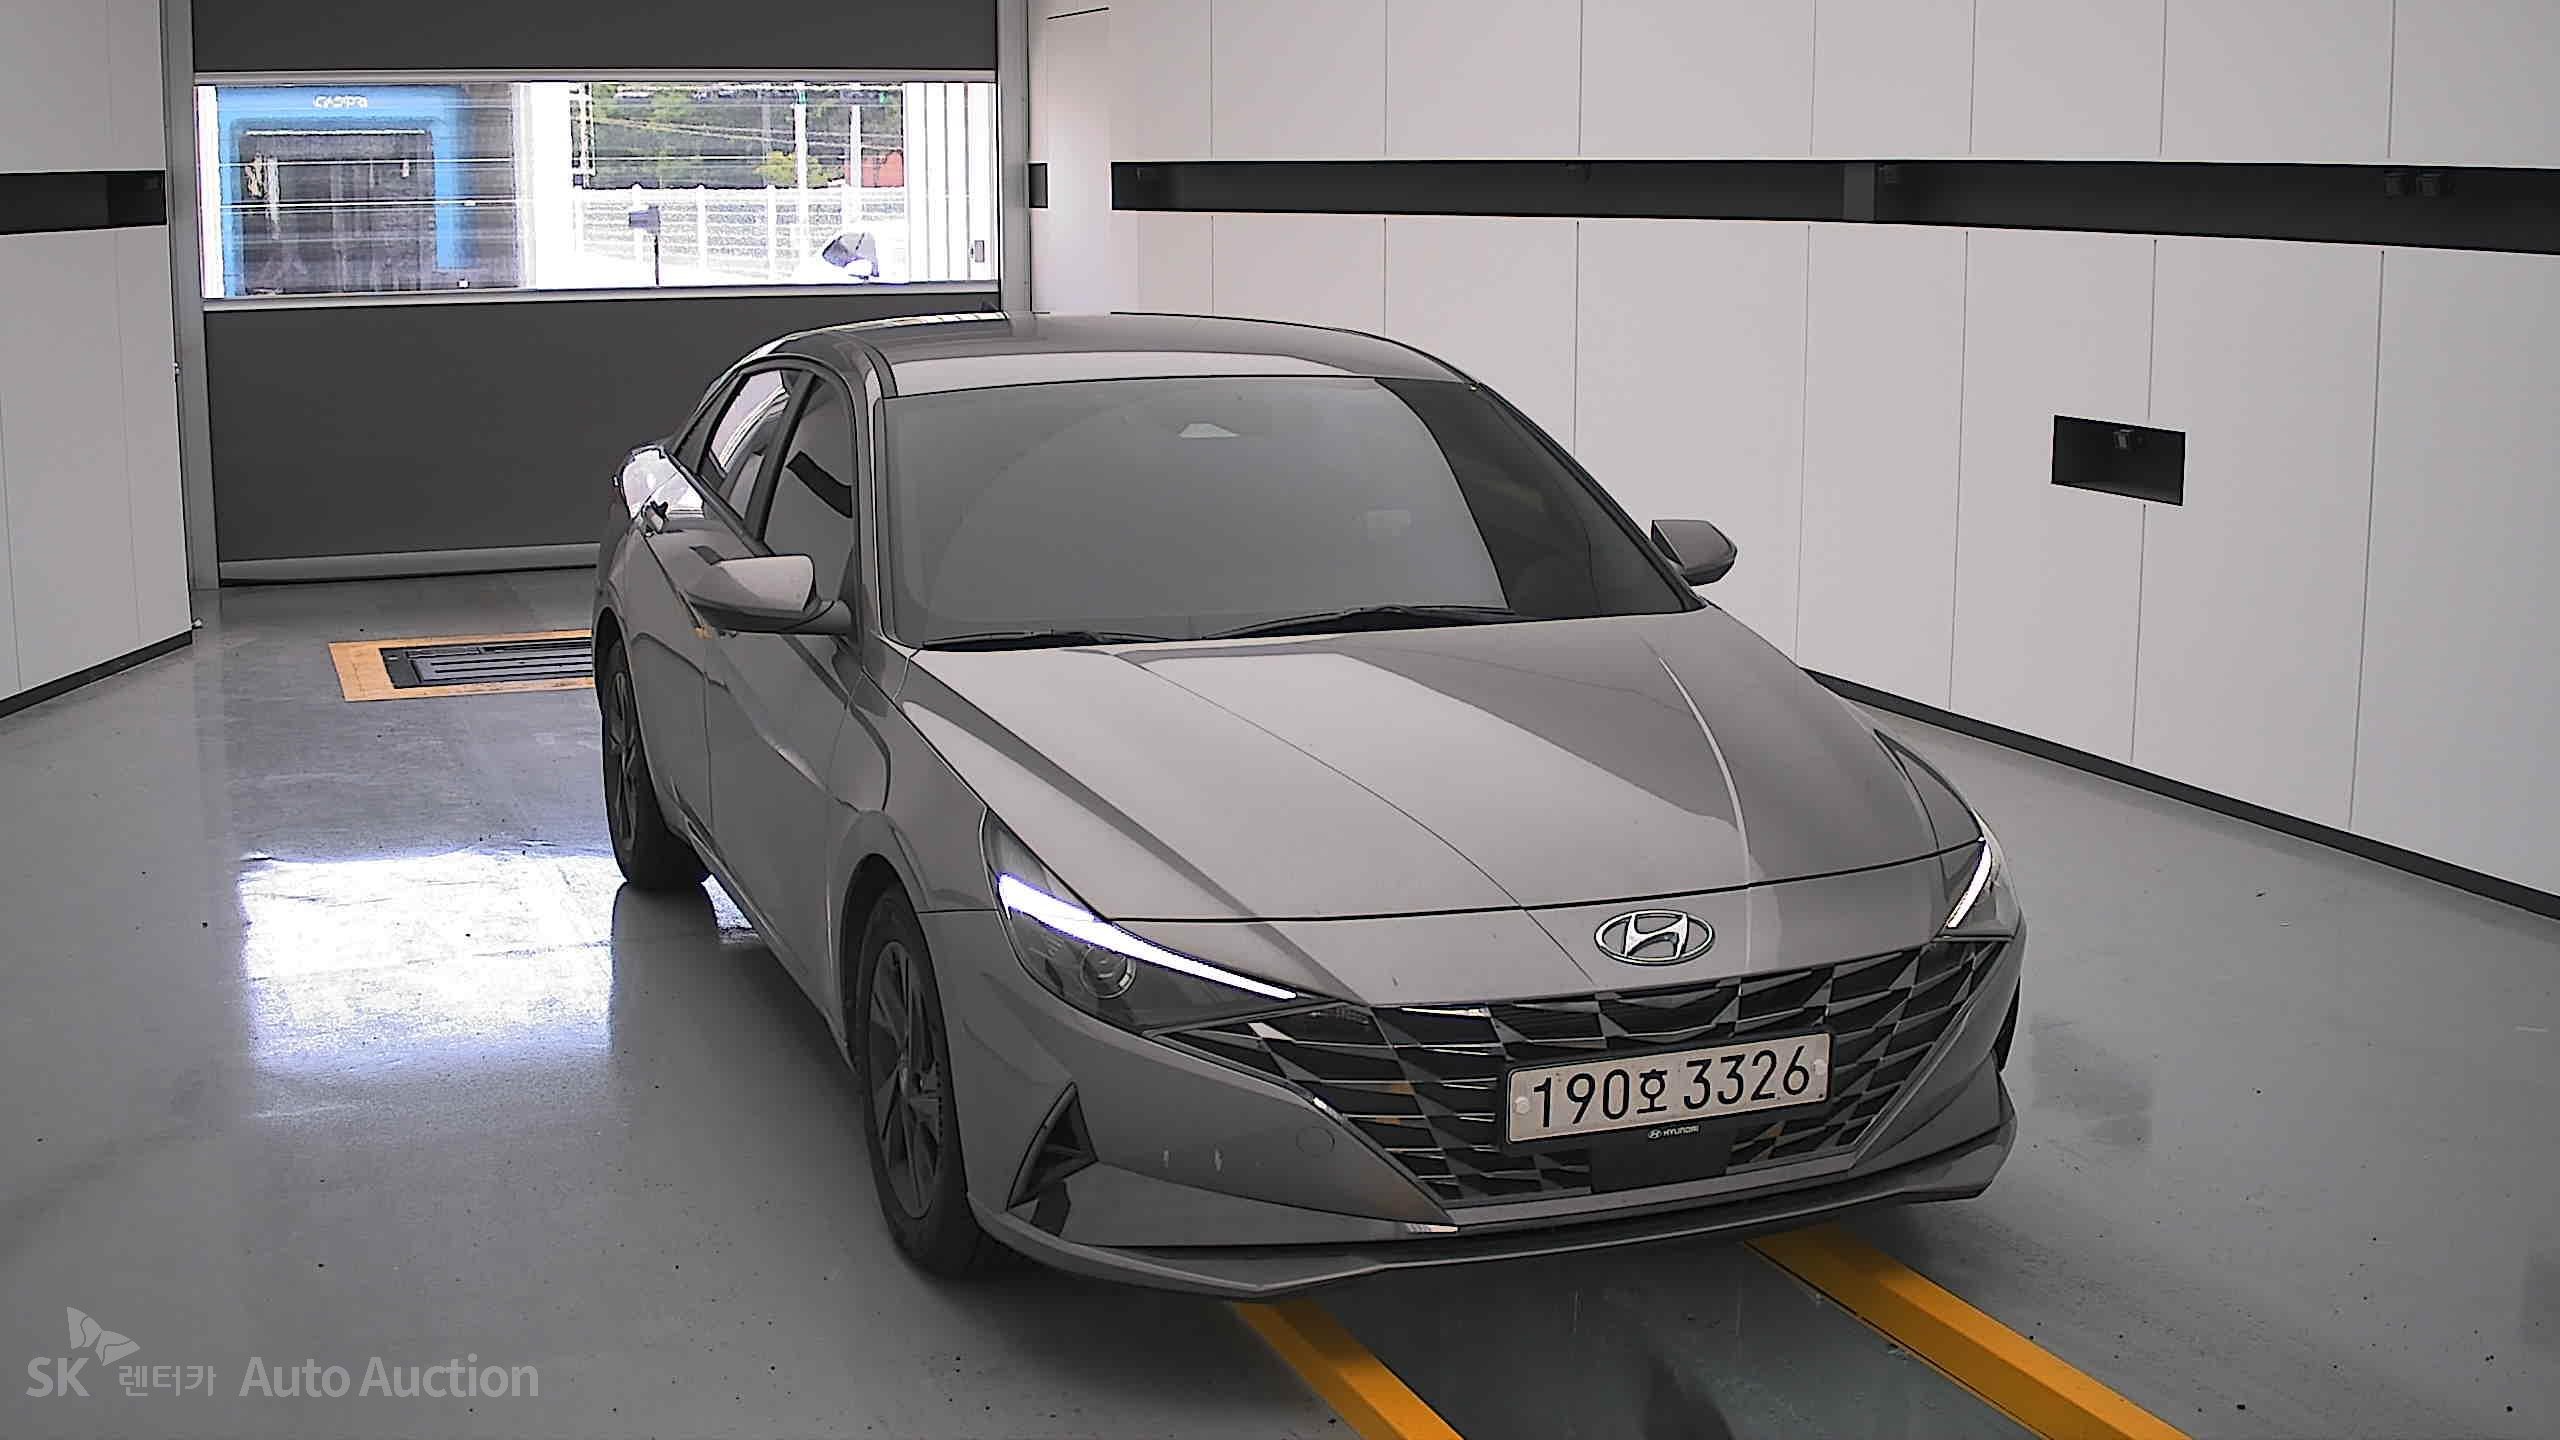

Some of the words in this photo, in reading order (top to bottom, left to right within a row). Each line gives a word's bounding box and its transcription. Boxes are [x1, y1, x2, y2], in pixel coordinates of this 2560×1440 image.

[1533, 1066, 1669, 1129] 190호
[1683, 1045, 1811, 1111] 3326
[1662, 1125, 1700, 1137] HYUNDAI
